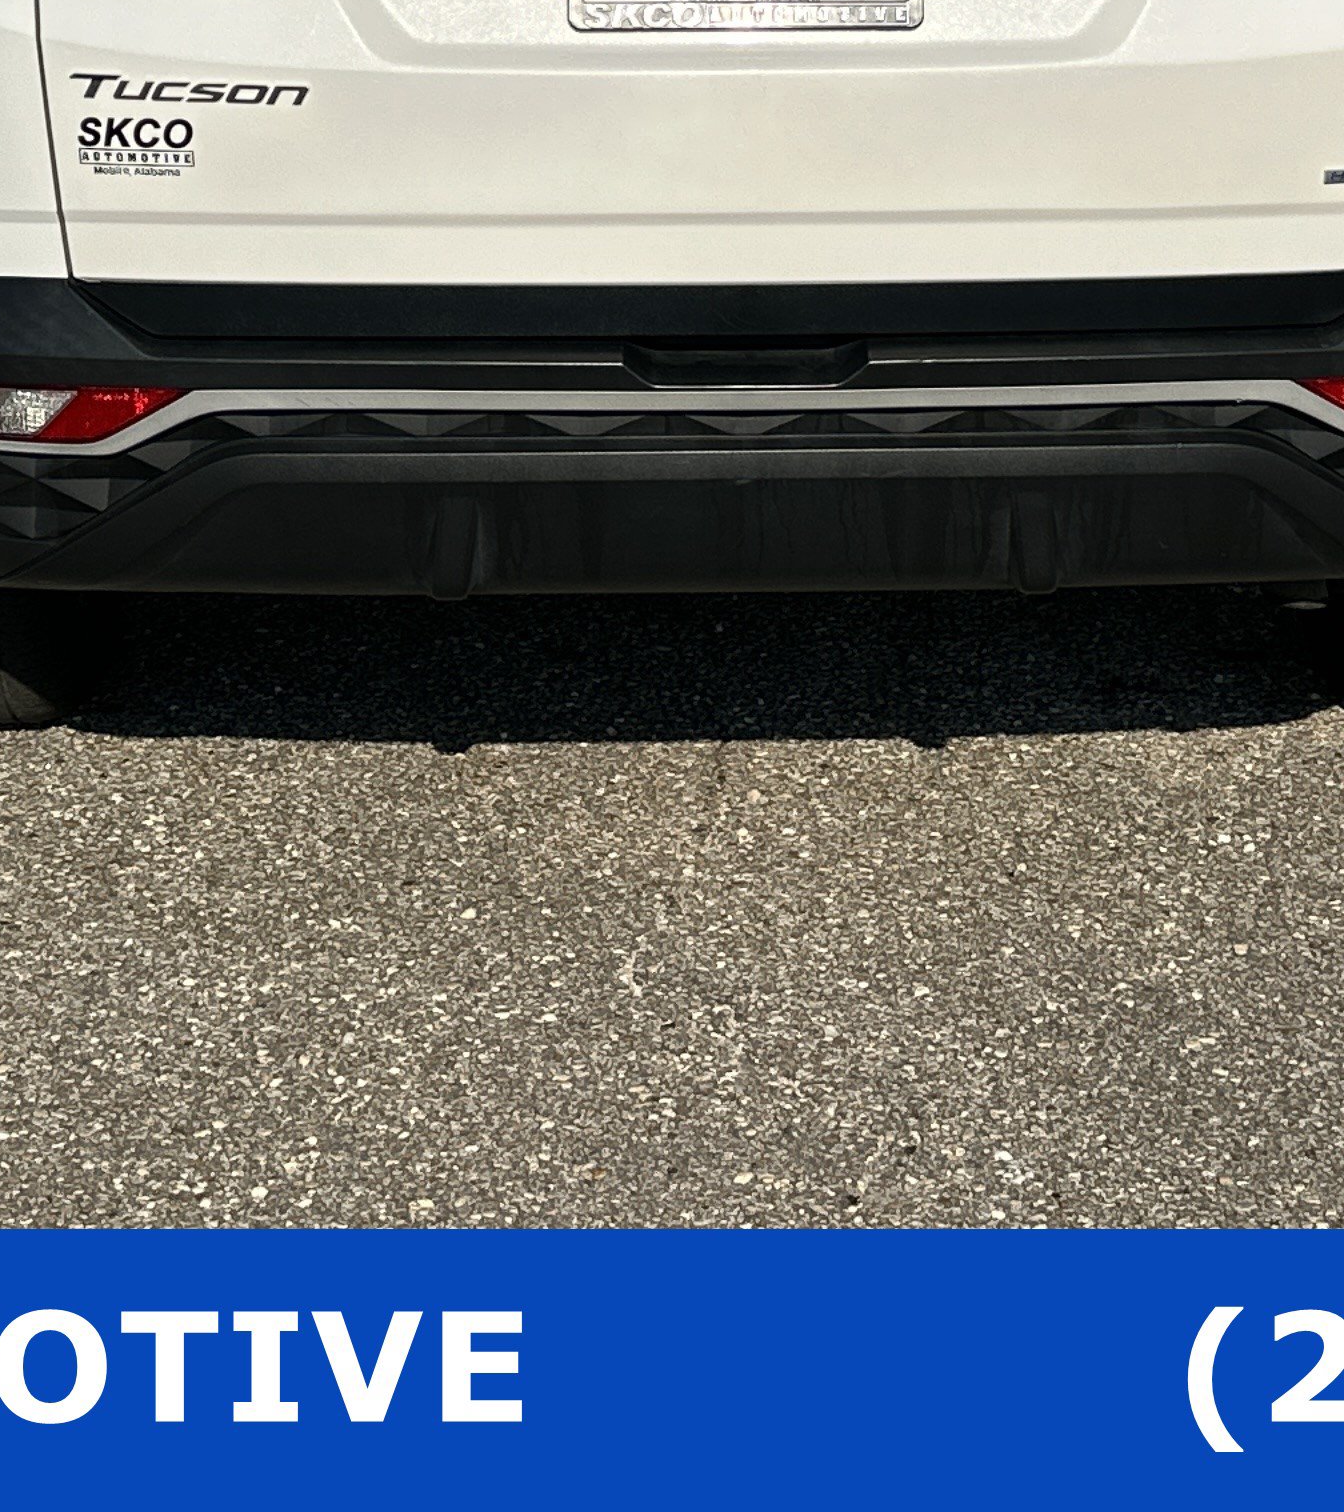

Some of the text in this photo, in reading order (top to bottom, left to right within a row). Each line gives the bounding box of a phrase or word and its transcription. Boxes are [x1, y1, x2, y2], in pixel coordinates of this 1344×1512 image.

[584, 3, 910, 29] SKCO AUTOMOTIVE
[77, 117, 194, 149] SKCO
[81, 151, 192, 164] AUTOMOTIVE
[134, 167, 181, 177] Alabama
